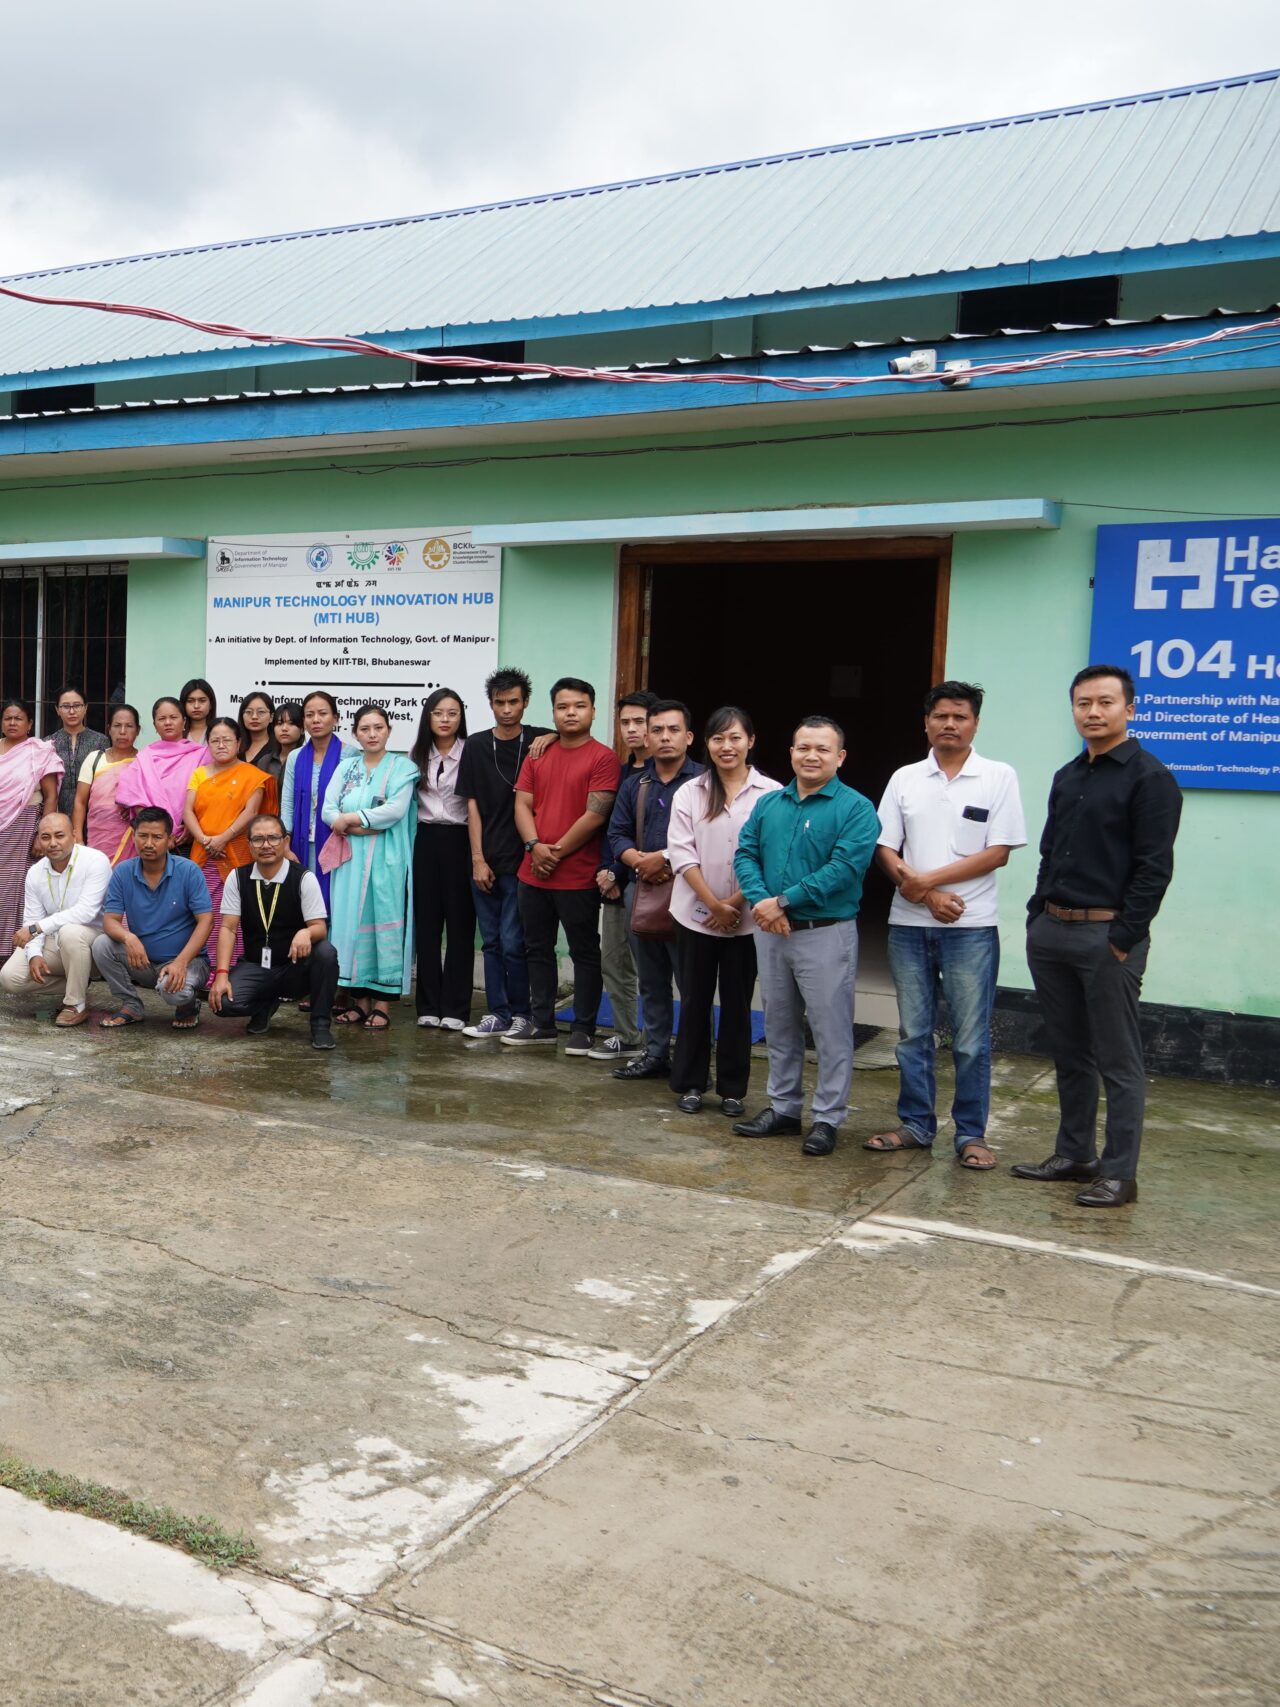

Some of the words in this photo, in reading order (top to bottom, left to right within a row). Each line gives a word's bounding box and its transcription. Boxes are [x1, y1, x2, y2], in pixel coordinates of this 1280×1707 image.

[213, 597, 271, 608] MANIPUR
[275, 595, 367, 608] TECHNOLOGY
[371, 593, 458, 606] INNOVATION
[462, 592, 494, 605] HUB
[313, 612, 341, 626] (MTI
[345, 612, 380, 626] HUB)
[263, 636, 273, 645] by
[275, 636, 296, 645] Dept.
[298, 635, 307, 643] of
[310, 635, 358, 643] Information
[361, 635, 413, 645] Technology,
[415, 635, 438, 643] Govt.
[441, 635, 450, 643] of
[453, 635, 490, 644] Manipur
[264, 658, 318, 667] Implemented
[320, 658, 330, 667] by
[332, 658, 369, 667] KIIT-TBI,
[371, 658, 431, 666] Bhubaneswar
[1130, 638, 1237, 679] 104
[1246, 655, 1280, 679] H
[271, 695, 304, 704] Inform
[332, 696, 391, 709] Technology
[394, 698, 418, 707] Park
[1144, 694, 1223, 708] Partnership
[1226, 694, 1256, 705] with
[1260, 695, 1280, 705] Na
[387, 711, 414, 722] West,
[1155, 711, 1230, 723] Directorate
[1233, 712, 1249, 724] of
[1126, 728, 1207, 740] Government
[1210, 730, 1227, 741] of
[1162, 763, 1214, 772] nformation
[1216, 764, 1271, 775] Technology
